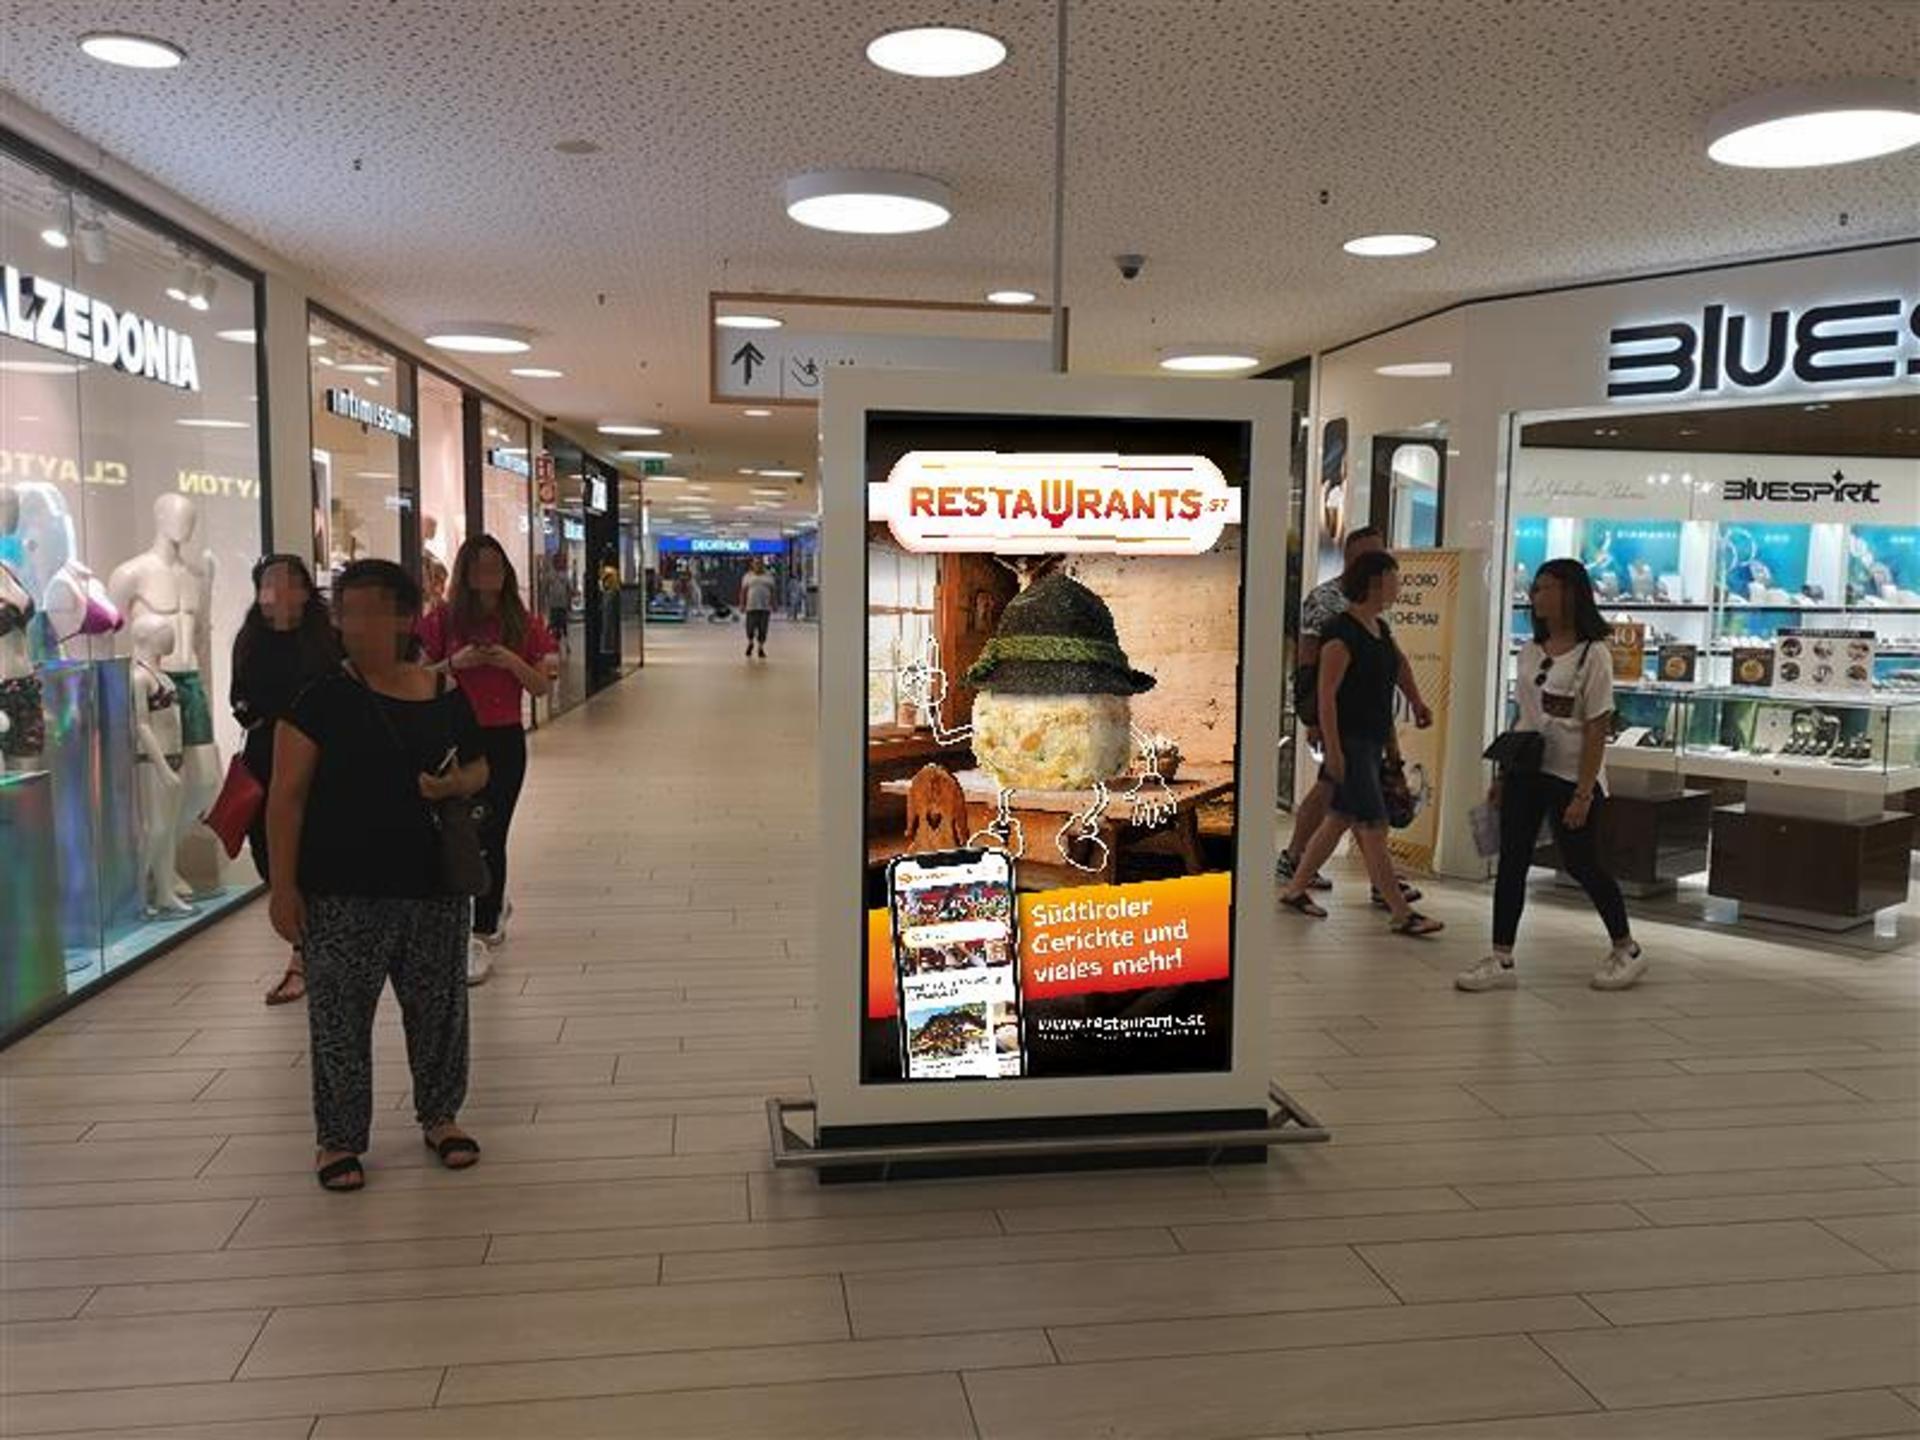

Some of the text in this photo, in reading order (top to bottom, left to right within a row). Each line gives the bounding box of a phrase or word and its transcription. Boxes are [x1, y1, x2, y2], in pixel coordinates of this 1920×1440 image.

[1607, 298, 1920, 397] BLUE
[1031, 896, 1153, 927] Südtiroler
[1031, 918, 1188, 954] Gerichte und
[1034, 947, 1182, 983] vieles mehr!
